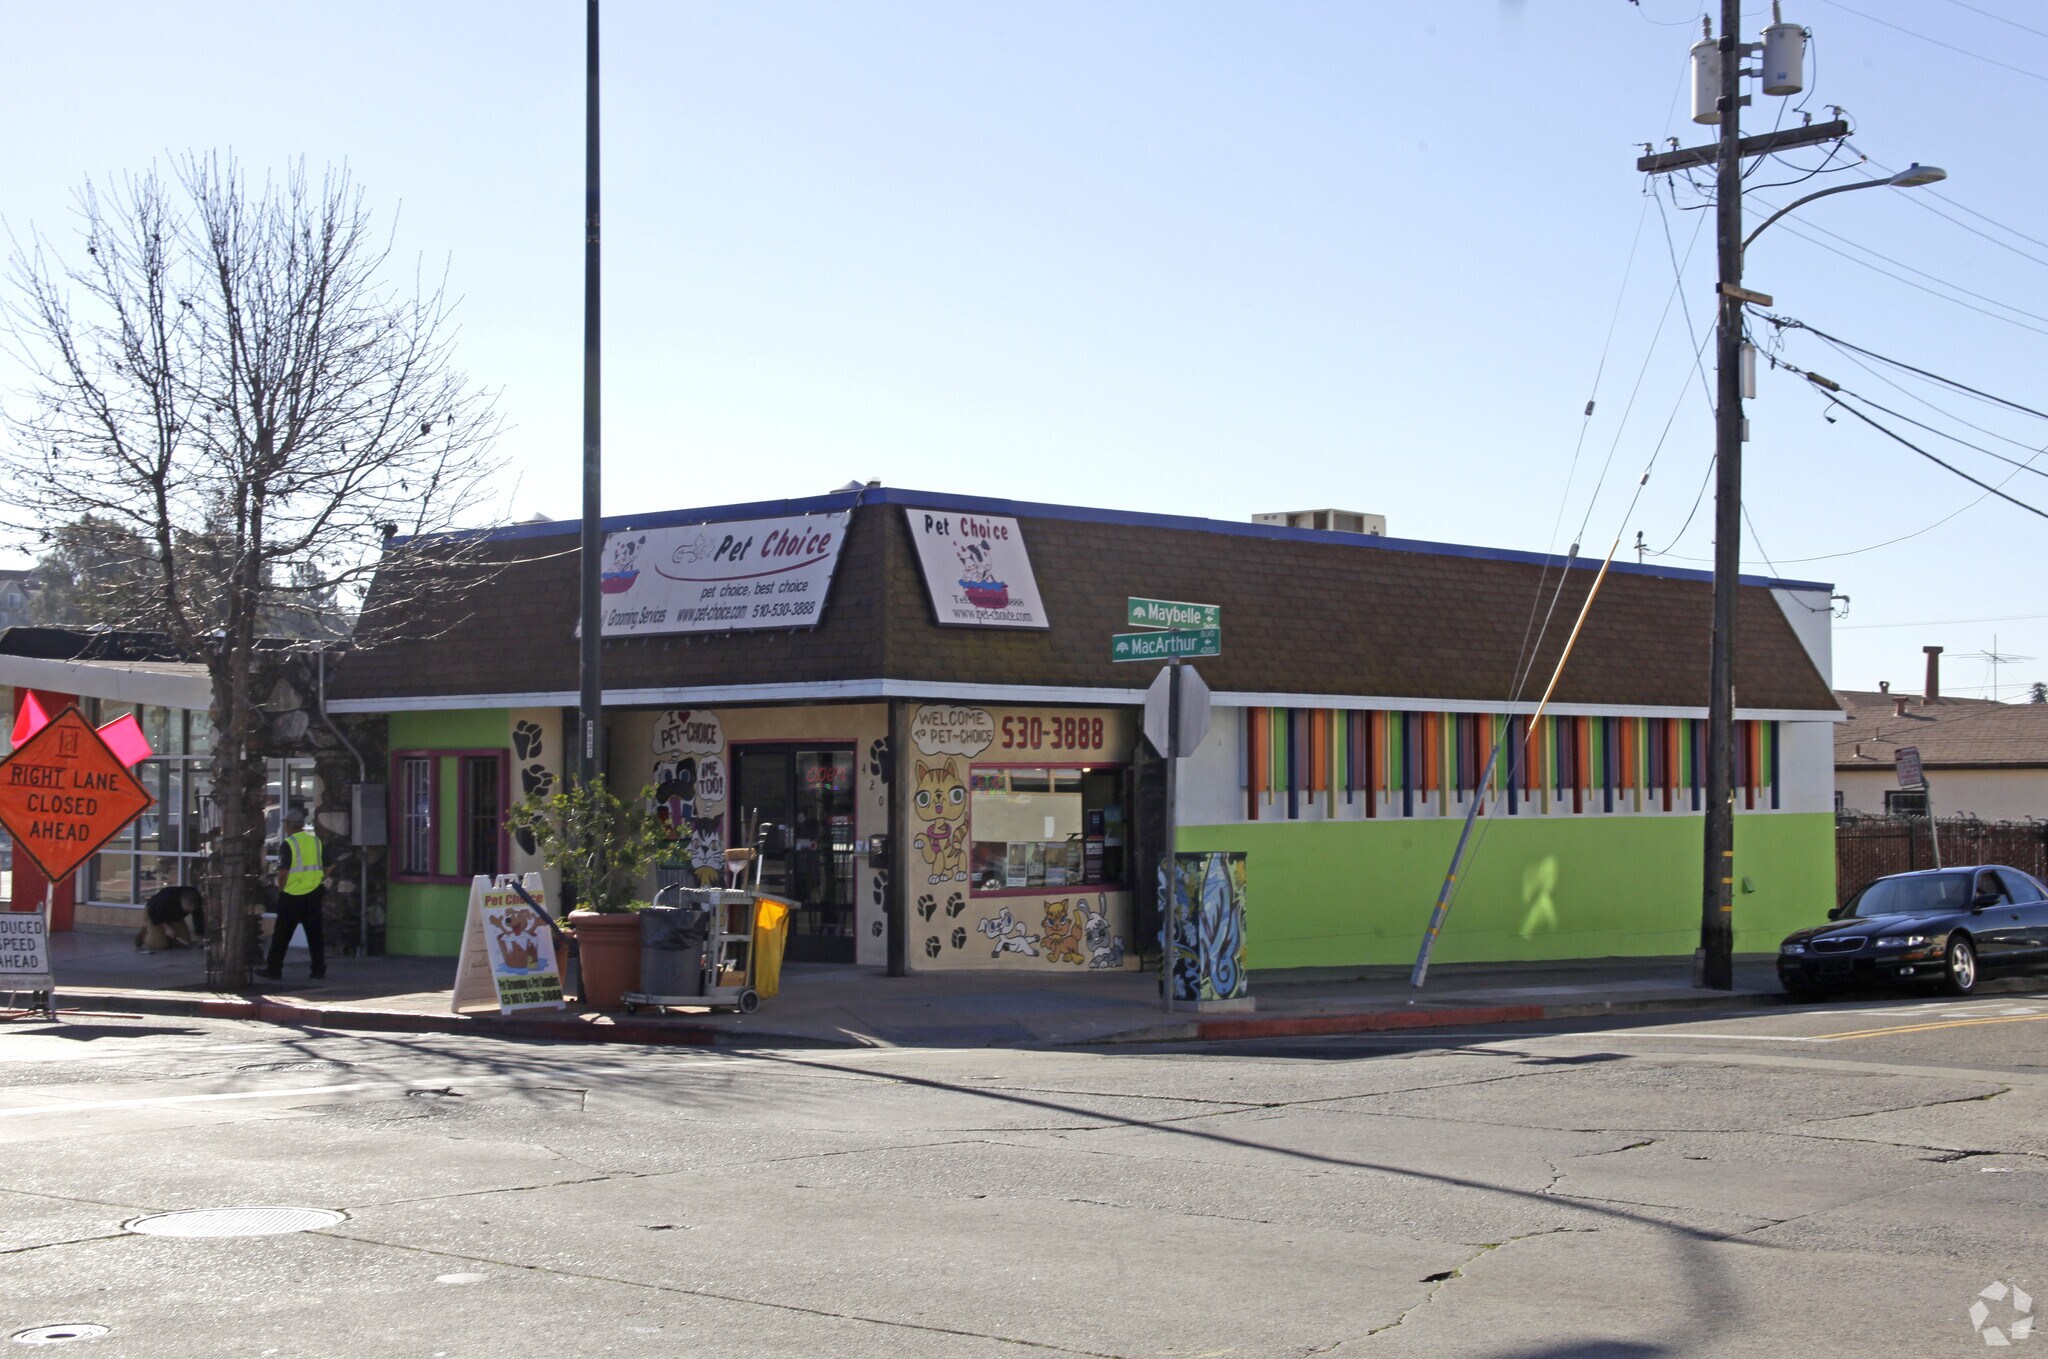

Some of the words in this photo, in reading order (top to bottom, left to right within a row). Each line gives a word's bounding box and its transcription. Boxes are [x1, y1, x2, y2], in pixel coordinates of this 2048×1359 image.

[924, 514, 950, 536] Pet
[960, 517, 1008, 541] Choice
[713, 534, 754, 563] Pet
[760, 526, 832, 558] Choice
[700, 585, 717, 600] pet
[753, 581, 775, 596] best
[778, 579, 809, 594] choice
[640, 606, 667, 625] Services
[676, 602, 748, 626] www.pet-choice.com
[751, 600, 816, 618] 510-530-3888
[1148, 602, 1201, 626] Maybelle
[1204, 607, 1215, 616] AVE
[1131, 636, 1198, 655] MacArthur
[668, 711, 675, 724] I
[919, 711, 986, 726] WELCOME
[11, 765, 64, 788] RIGHT
[73, 771, 119, 791] LANE
[699, 776, 723, 795] TOO!
[27, 794, 97, 816] CLOSED
[29, 821, 90, 842] AHEAD
[484, 896, 503, 907] Pet
